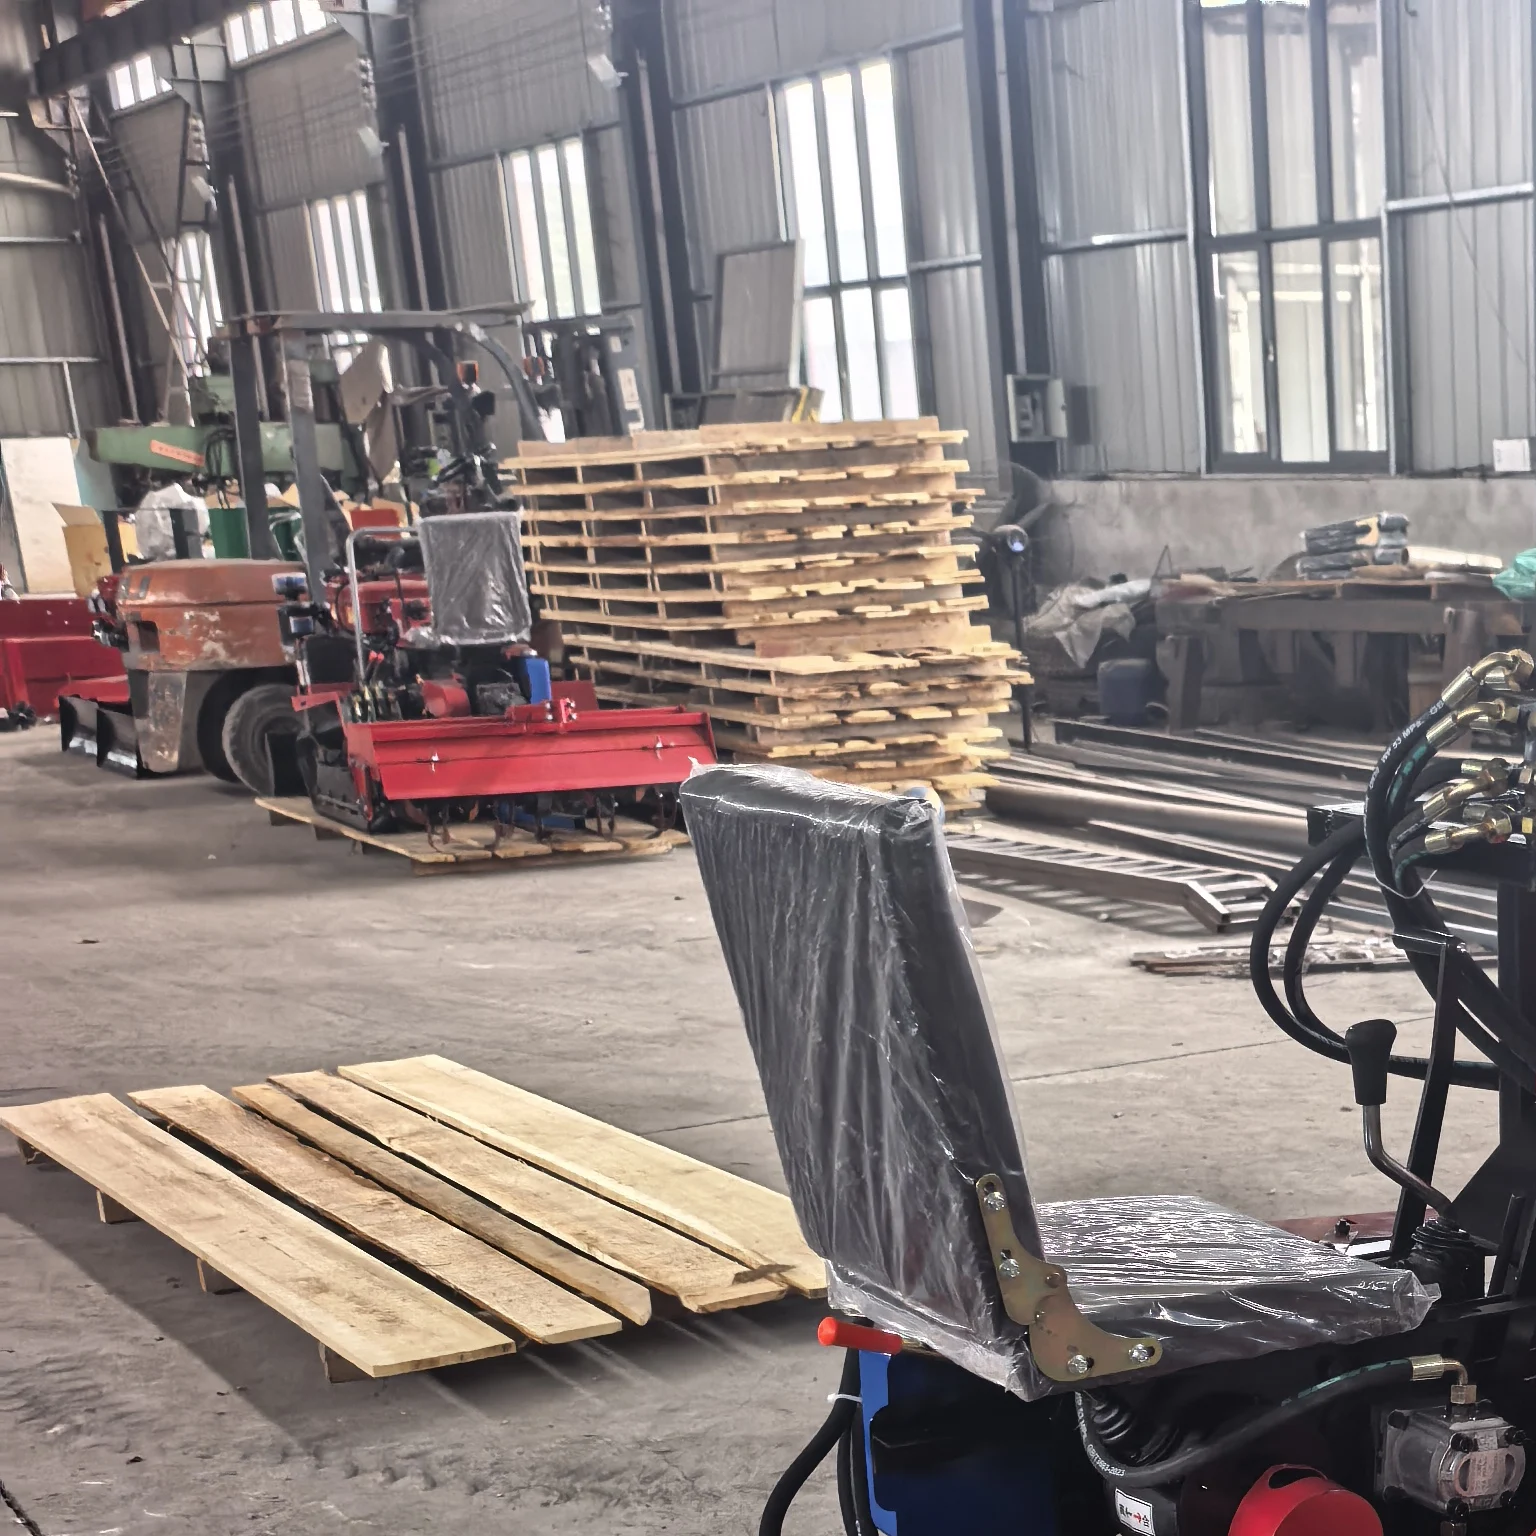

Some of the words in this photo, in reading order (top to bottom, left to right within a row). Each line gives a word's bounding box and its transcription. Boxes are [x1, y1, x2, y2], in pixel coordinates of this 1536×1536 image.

[1392, 736, 1402, 749] 53
[1087, 1444, 1126, 1476] GB/T3683-2023
[1141, 1514, 1150, 1528] 合
